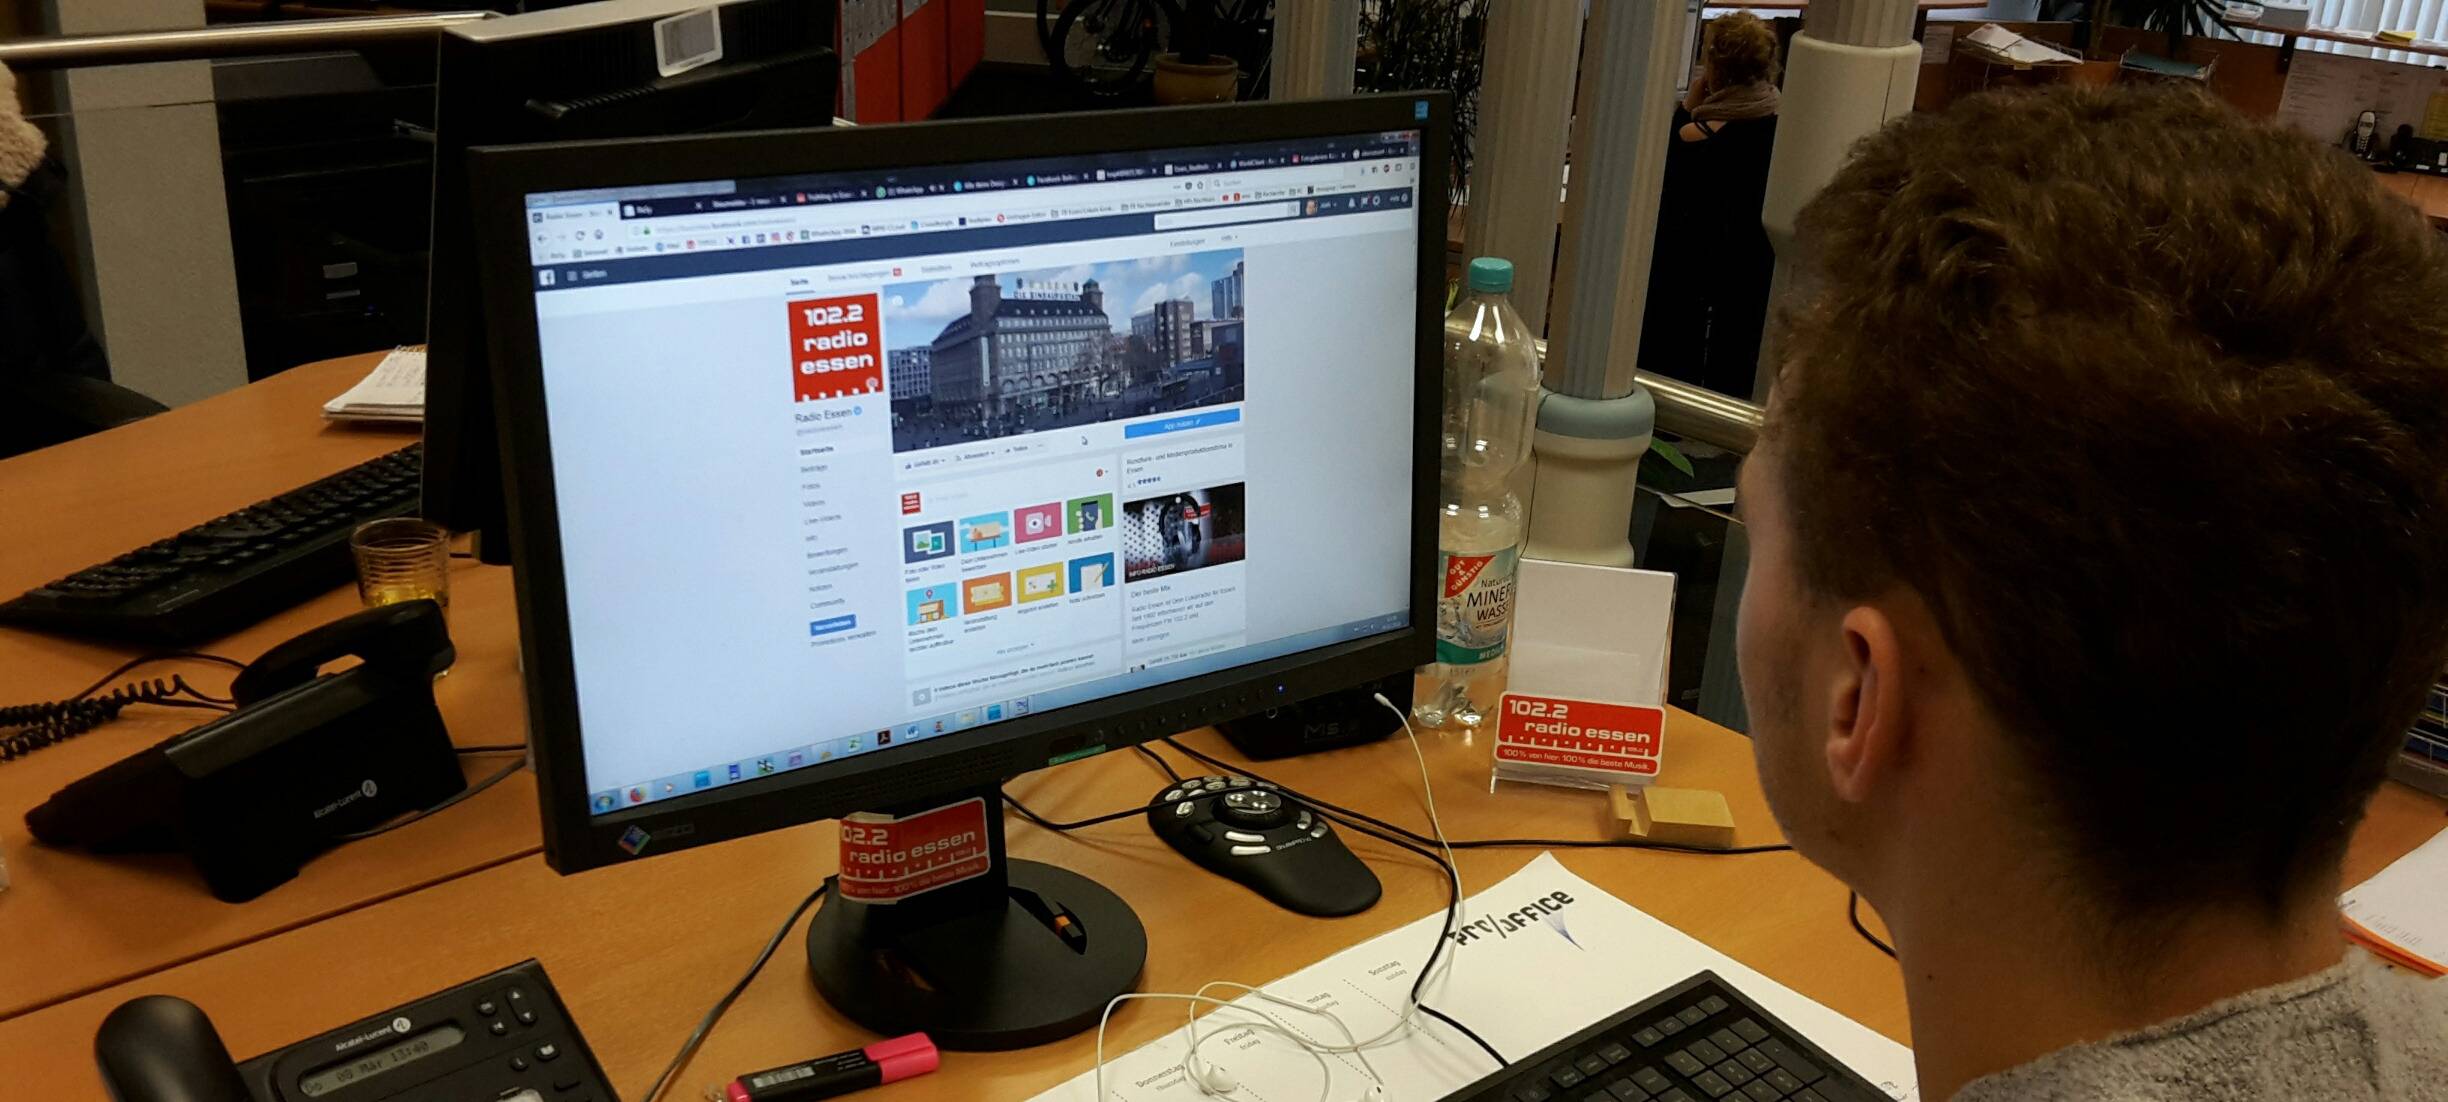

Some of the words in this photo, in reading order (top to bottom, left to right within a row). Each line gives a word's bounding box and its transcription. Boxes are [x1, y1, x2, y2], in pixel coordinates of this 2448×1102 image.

[803, 304, 864, 327] 102.2
[803, 330, 868, 352] radio
[800, 353, 874, 375] essen
[795, 411, 821, 424] Radio
[824, 408, 852, 421] Essen
[1509, 700, 1568, 720] 102.2
[1525, 722, 1581, 737] radio
[1585, 727, 1650, 743] essen
[1587, 757, 1599, 765] die
[1600, 759, 1623, 769] beste
[841, 825, 888, 846] 02.2
[850, 849, 906, 865] radio
[911, 831, 975, 858] essen
[1368, 960, 1401, 977] Sonntag
[335, 1026, 393, 1052] Alcatel-Lucent
[1224, 1028, 1256, 1046] Freitag
[1135, 1063, 1185, 1088] Donnerstag
